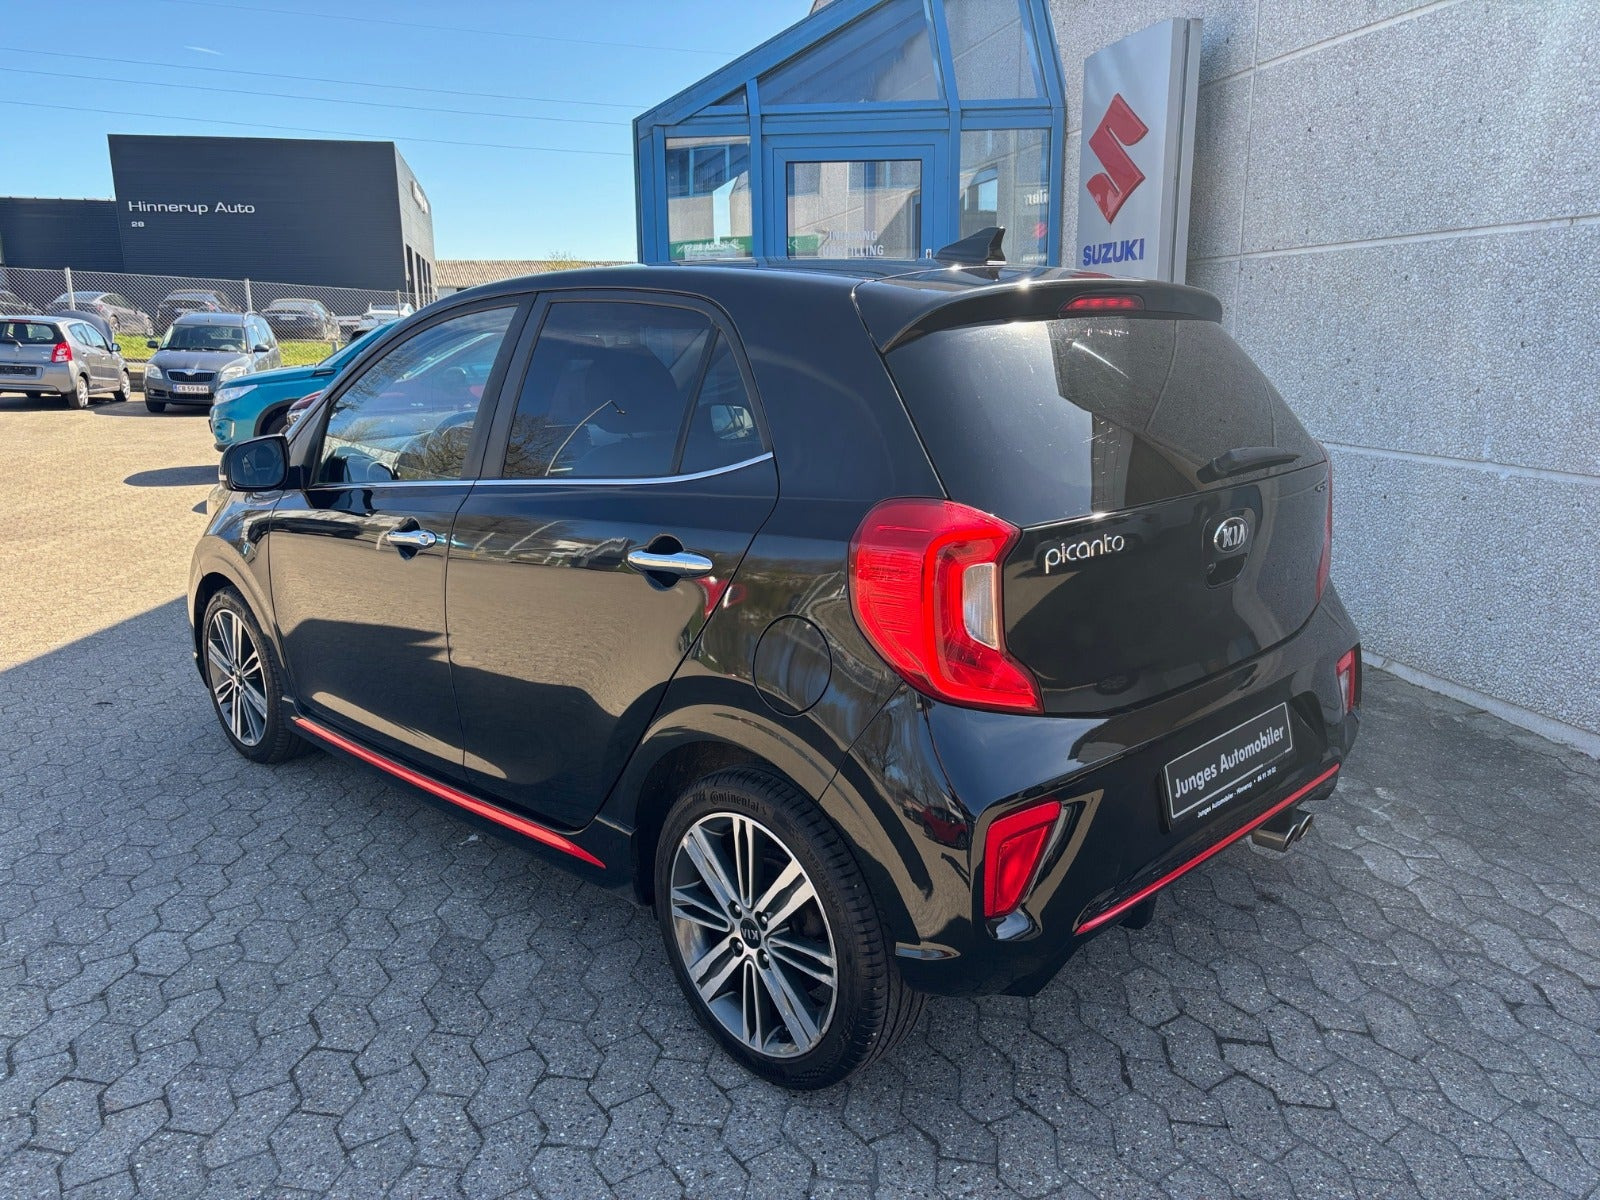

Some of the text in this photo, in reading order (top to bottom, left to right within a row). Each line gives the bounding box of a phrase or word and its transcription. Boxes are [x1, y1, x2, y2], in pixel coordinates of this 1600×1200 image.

[128, 200, 256, 216] Hinnerup Auto
[1083, 238, 1145, 267] SUZUKI
[1222, 523, 1247, 548] KIA
[1045, 533, 1125, 575] picanto
[1175, 726, 1285, 798] Junges Automobiler
[710, 790, 760, 812] Continental
[741, 927, 759, 940] KIA
